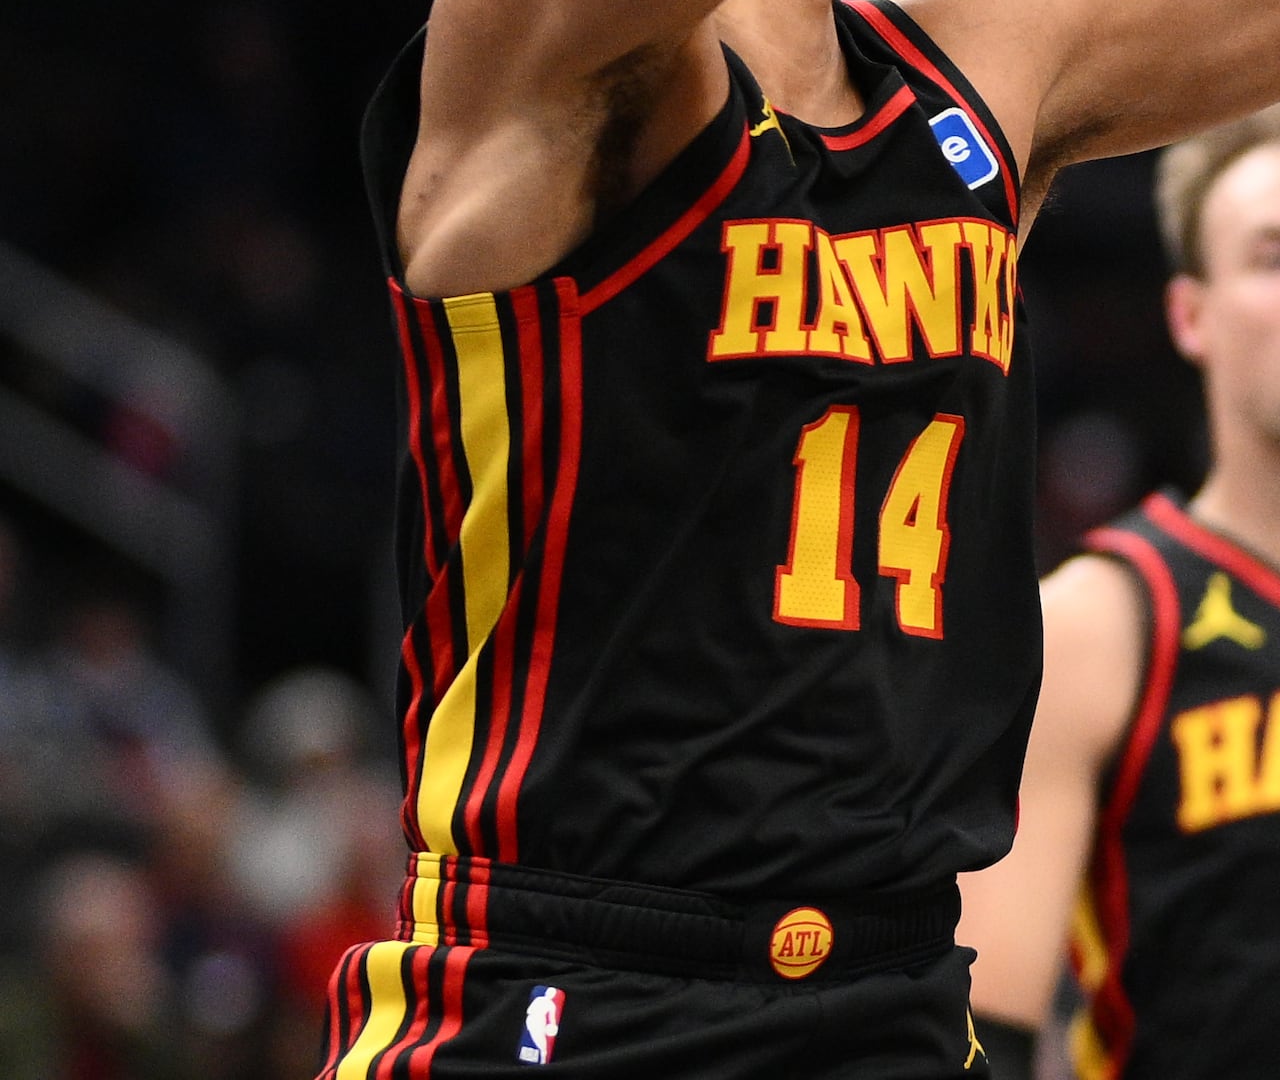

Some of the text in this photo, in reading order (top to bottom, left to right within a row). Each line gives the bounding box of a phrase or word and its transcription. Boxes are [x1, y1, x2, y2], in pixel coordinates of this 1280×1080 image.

[706, 218, 1018, 377] HAWKS
[772, 404, 964, 640] 14
[778, 930, 823, 957] ATL
